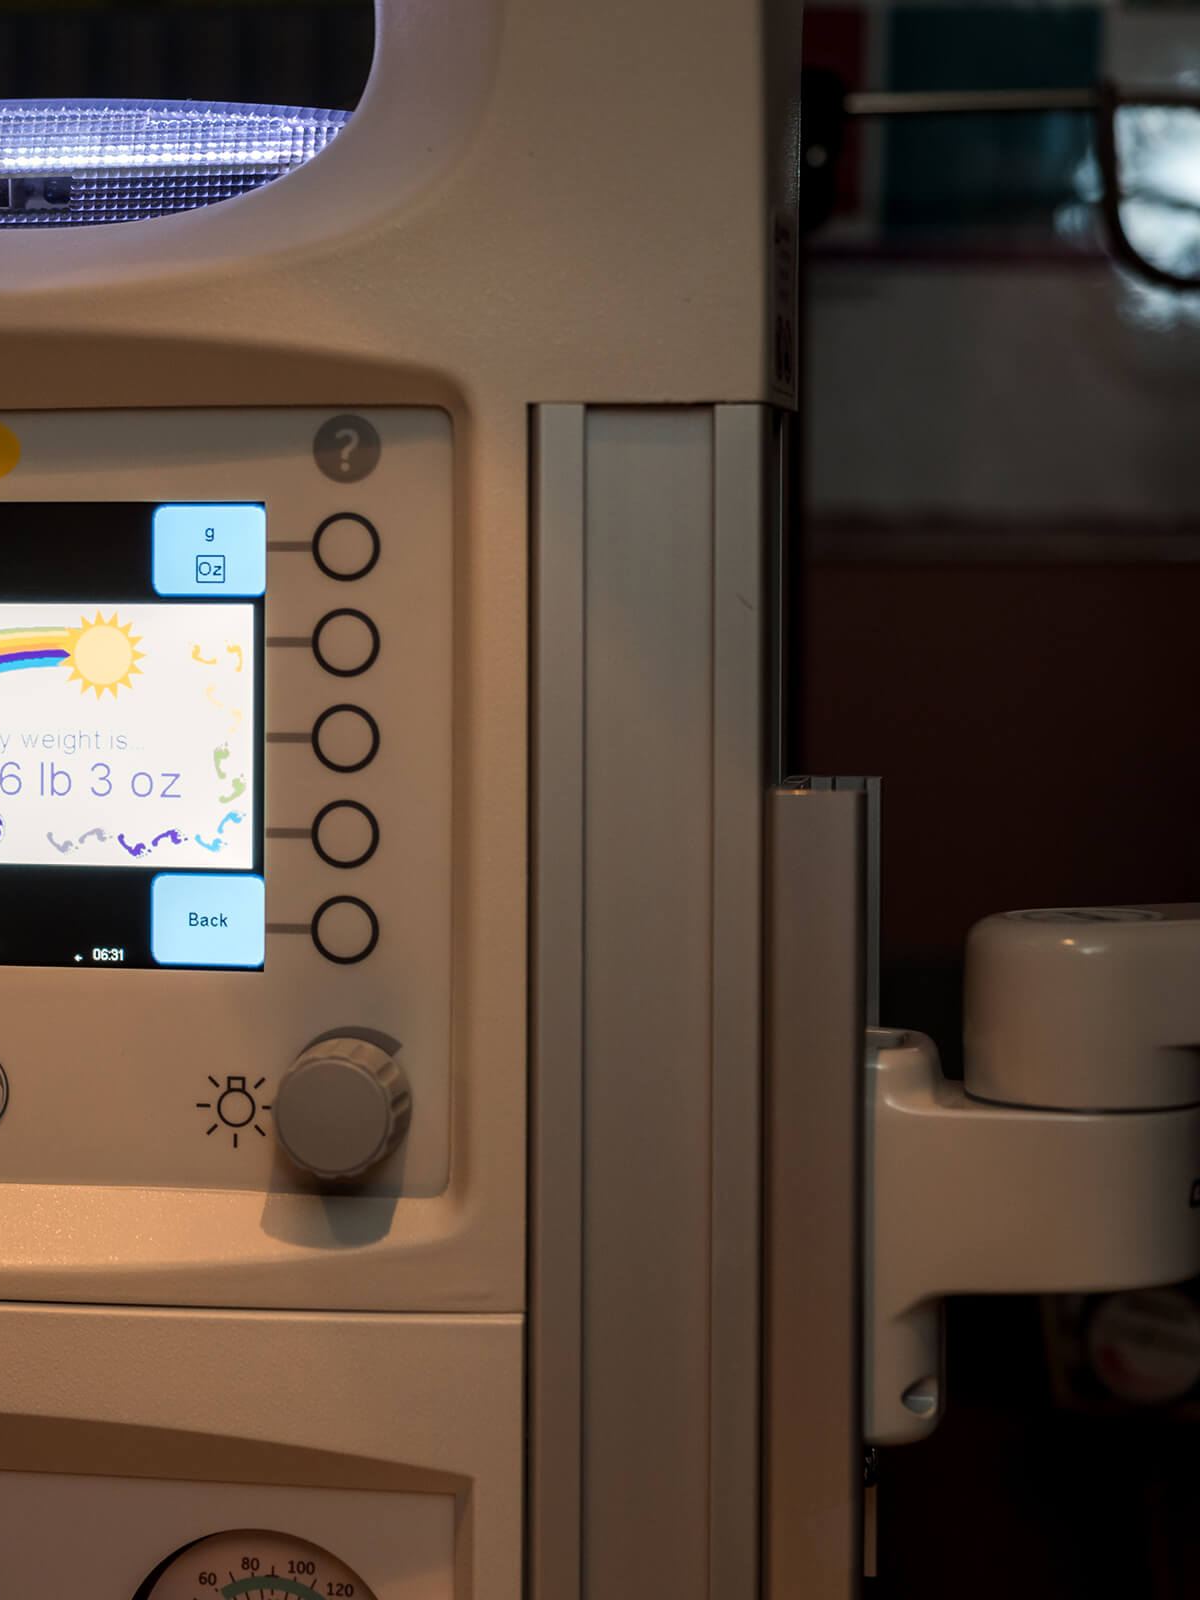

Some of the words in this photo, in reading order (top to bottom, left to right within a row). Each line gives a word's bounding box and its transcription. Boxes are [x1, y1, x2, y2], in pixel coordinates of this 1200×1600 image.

[205, 527, 215, 542] g
[198, 561, 222, 576] Oz
[21, 729, 101, 755] weight
[0, 761, 22, 796] 6
[40, 761, 72, 797] lb
[90, 762, 113, 797] 3
[131, 771, 181, 798] oz
[188, 913, 228, 927] Back
[92, 948, 125, 961] 06:31
[241, 1557, 260, 1571] 80
[288, 1560, 316, 1576] 100
[198, 1571, 217, 1586] 60
[326, 1582, 354, 1597] 120
